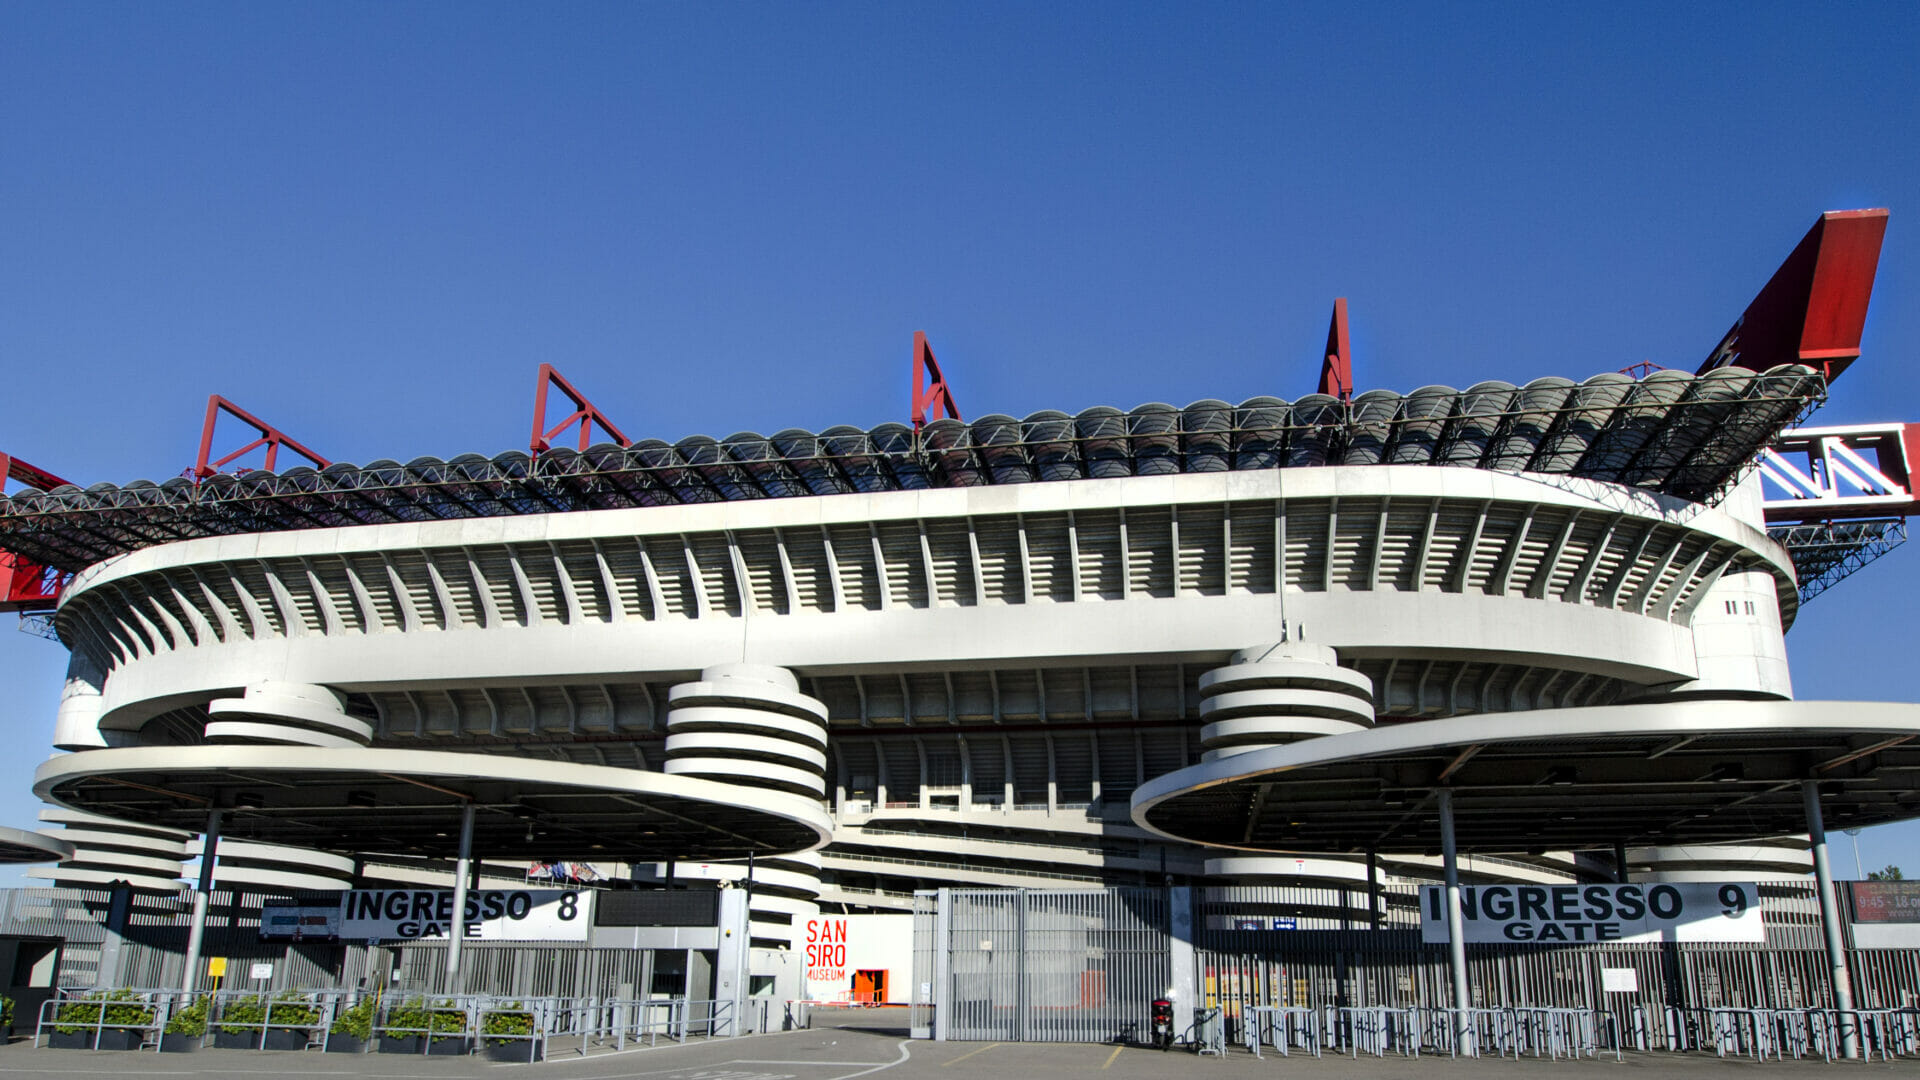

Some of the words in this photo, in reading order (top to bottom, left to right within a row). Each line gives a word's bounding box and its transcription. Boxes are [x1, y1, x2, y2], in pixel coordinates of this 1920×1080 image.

[346, 891, 532, 921] INGRESSO
[557, 891, 579, 921] 8
[1429, 886, 1683, 921] INGRESSO
[1718, 885, 1748, 920] 9
[806, 919, 847, 943] SAN
[1503, 922, 1622, 941] GATE
[806, 944, 846, 967] SIRO
